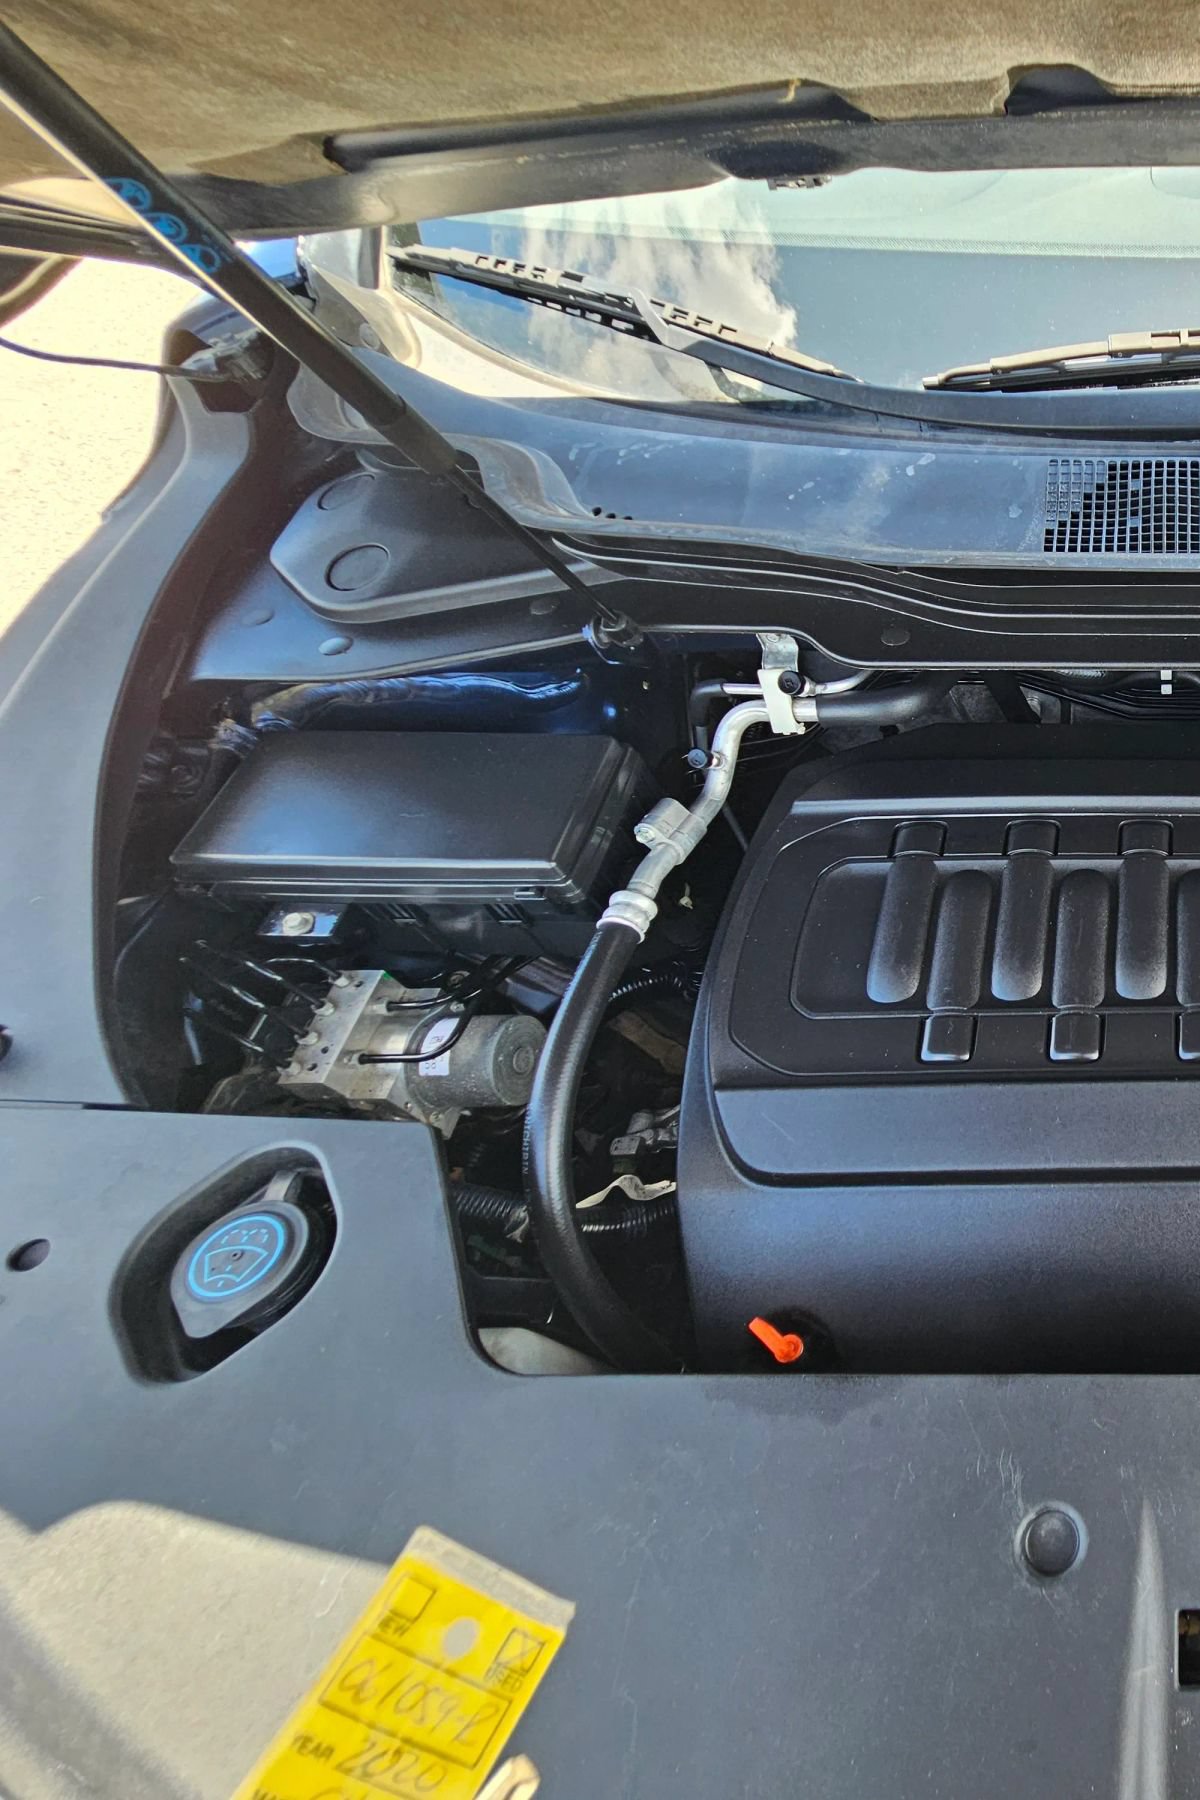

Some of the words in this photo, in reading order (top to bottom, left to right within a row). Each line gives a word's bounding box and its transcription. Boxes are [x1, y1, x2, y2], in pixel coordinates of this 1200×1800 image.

[484, 1662, 523, 1693] USED
[292, 1731, 335, 1760] YEAR
[335, 1733, 448, 1792] 2020
